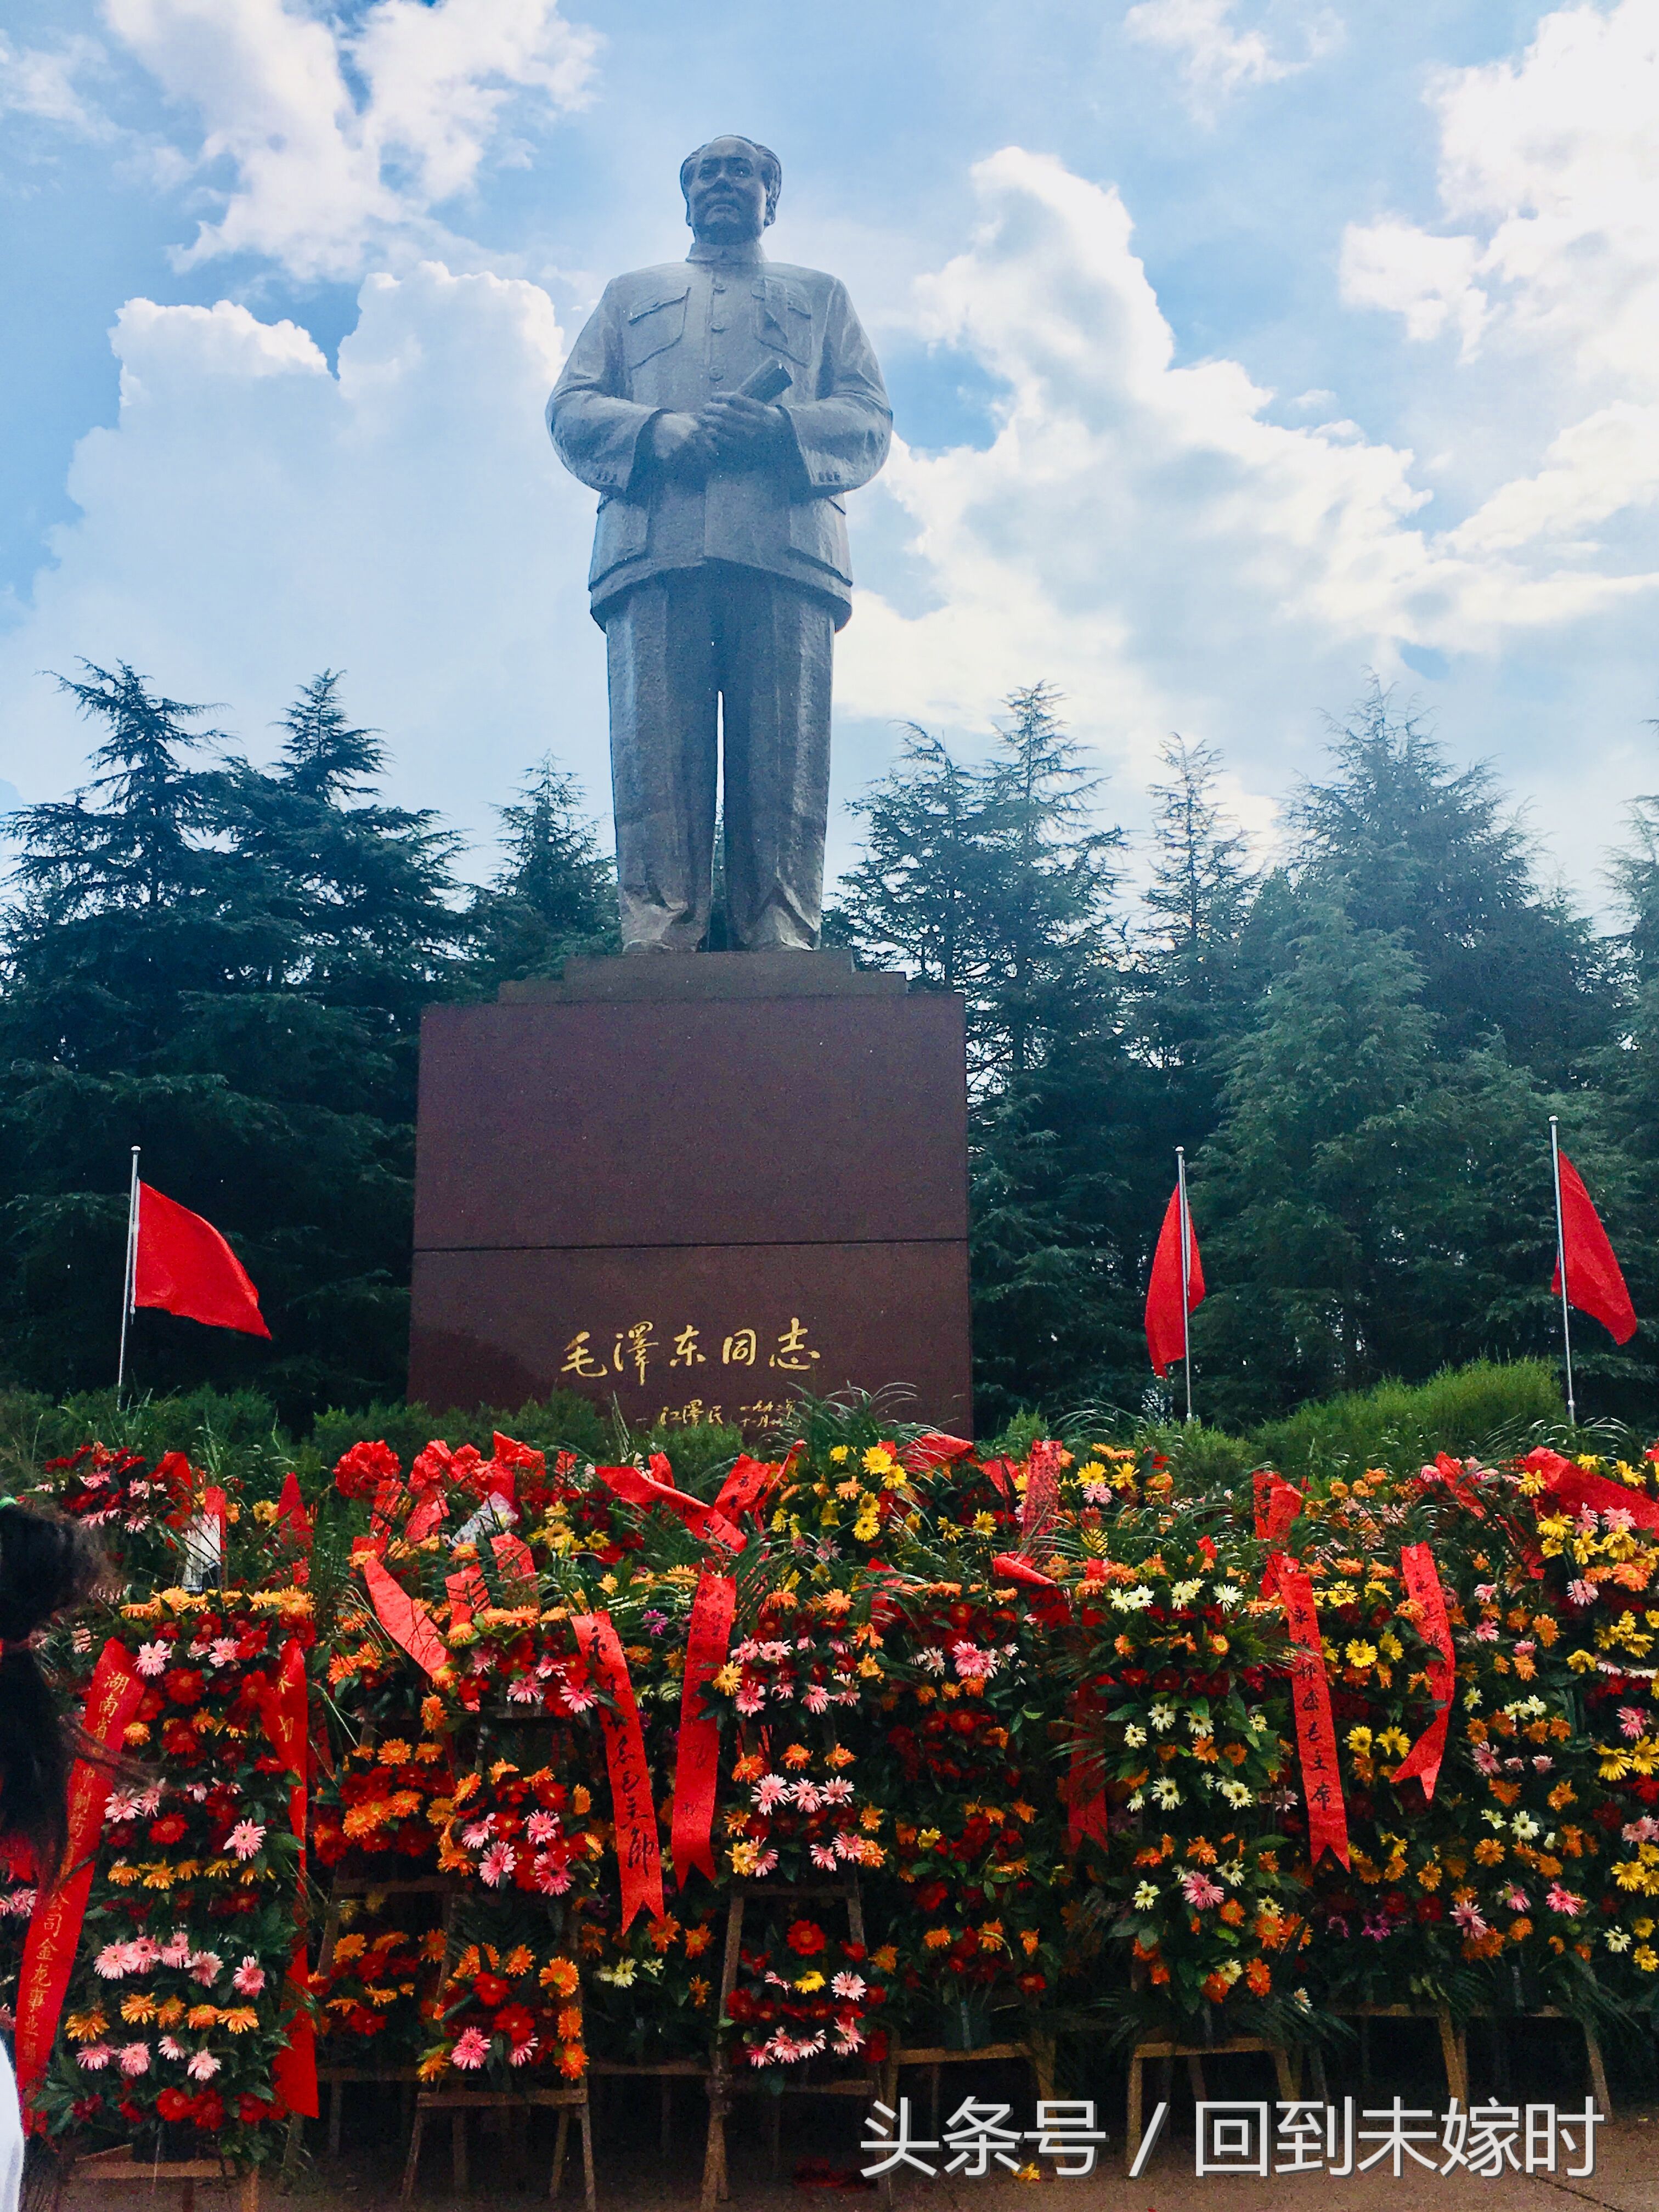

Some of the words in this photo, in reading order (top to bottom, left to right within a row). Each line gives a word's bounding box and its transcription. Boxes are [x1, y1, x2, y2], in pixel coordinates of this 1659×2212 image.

[589, 1626, 654, 1878] 永念毛主席
